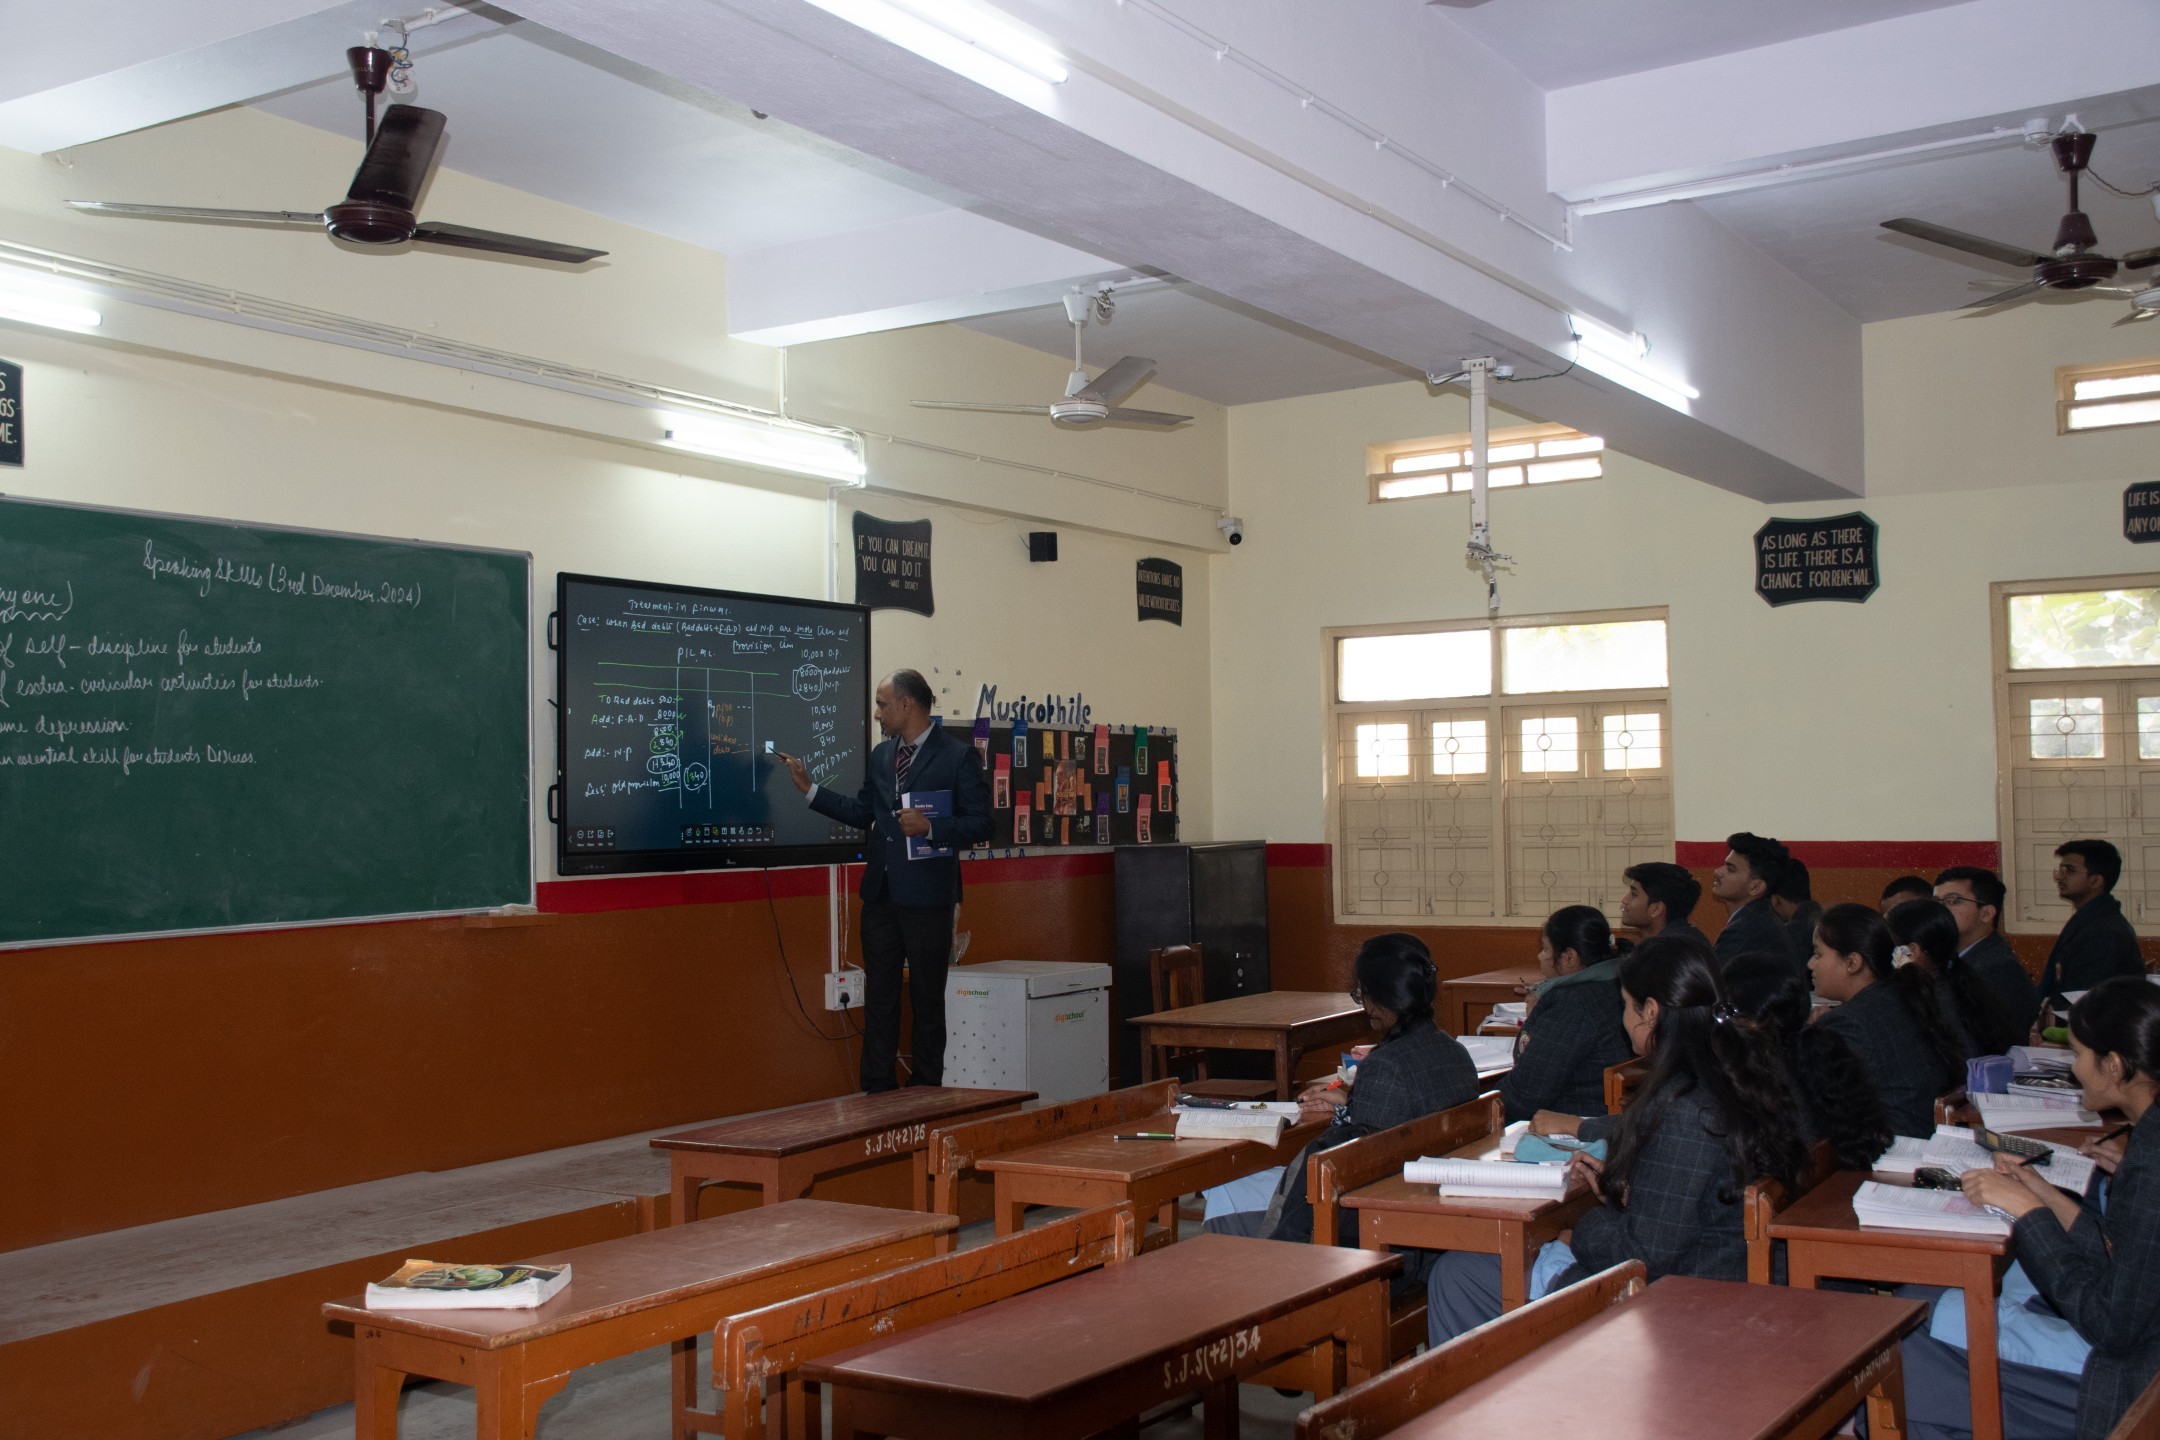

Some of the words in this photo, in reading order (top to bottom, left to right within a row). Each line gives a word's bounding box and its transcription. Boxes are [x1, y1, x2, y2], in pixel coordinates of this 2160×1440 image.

[2128, 492, 2147, 507] LIFE
[2150, 490, 2160, 505] IS
[2127, 516, 2148, 534] ANY
[858, 534, 864, 551] IF
[867, 536, 882, 553] YOU
[885, 538, 899, 555] CAN
[1761, 535, 1776, 551] AS
[1778, 533, 1807, 549] LONG
[1811, 531, 1827, 547] AS
[1831, 527, 1863, 545] THERE
[143, 540, 211, 597] Speaking
[862, 555, 877, 572] YOU
[882, 558, 897, 574] CAN
[902, 561, 913, 577] DO
[1765, 553, 1776, 569] IS
[1804, 549, 1839, 566] THERE
[1841, 548, 1853, 564] IS
[1855, 547, 1864, 564] A
[1761, 572, 1803, 589] CHANCE
[1809, 570, 1831, 588] FOR
[606, 618, 628, 628] when
[178, 629, 198, 665] for
[204, 636, 262, 655] students
[242, 668, 263, 701] for
[17, 746, 78, 765] essential
[83, 747, 120, 765] skill
[124, 746, 143, 775] for
[146, 746, 200, 765] students
